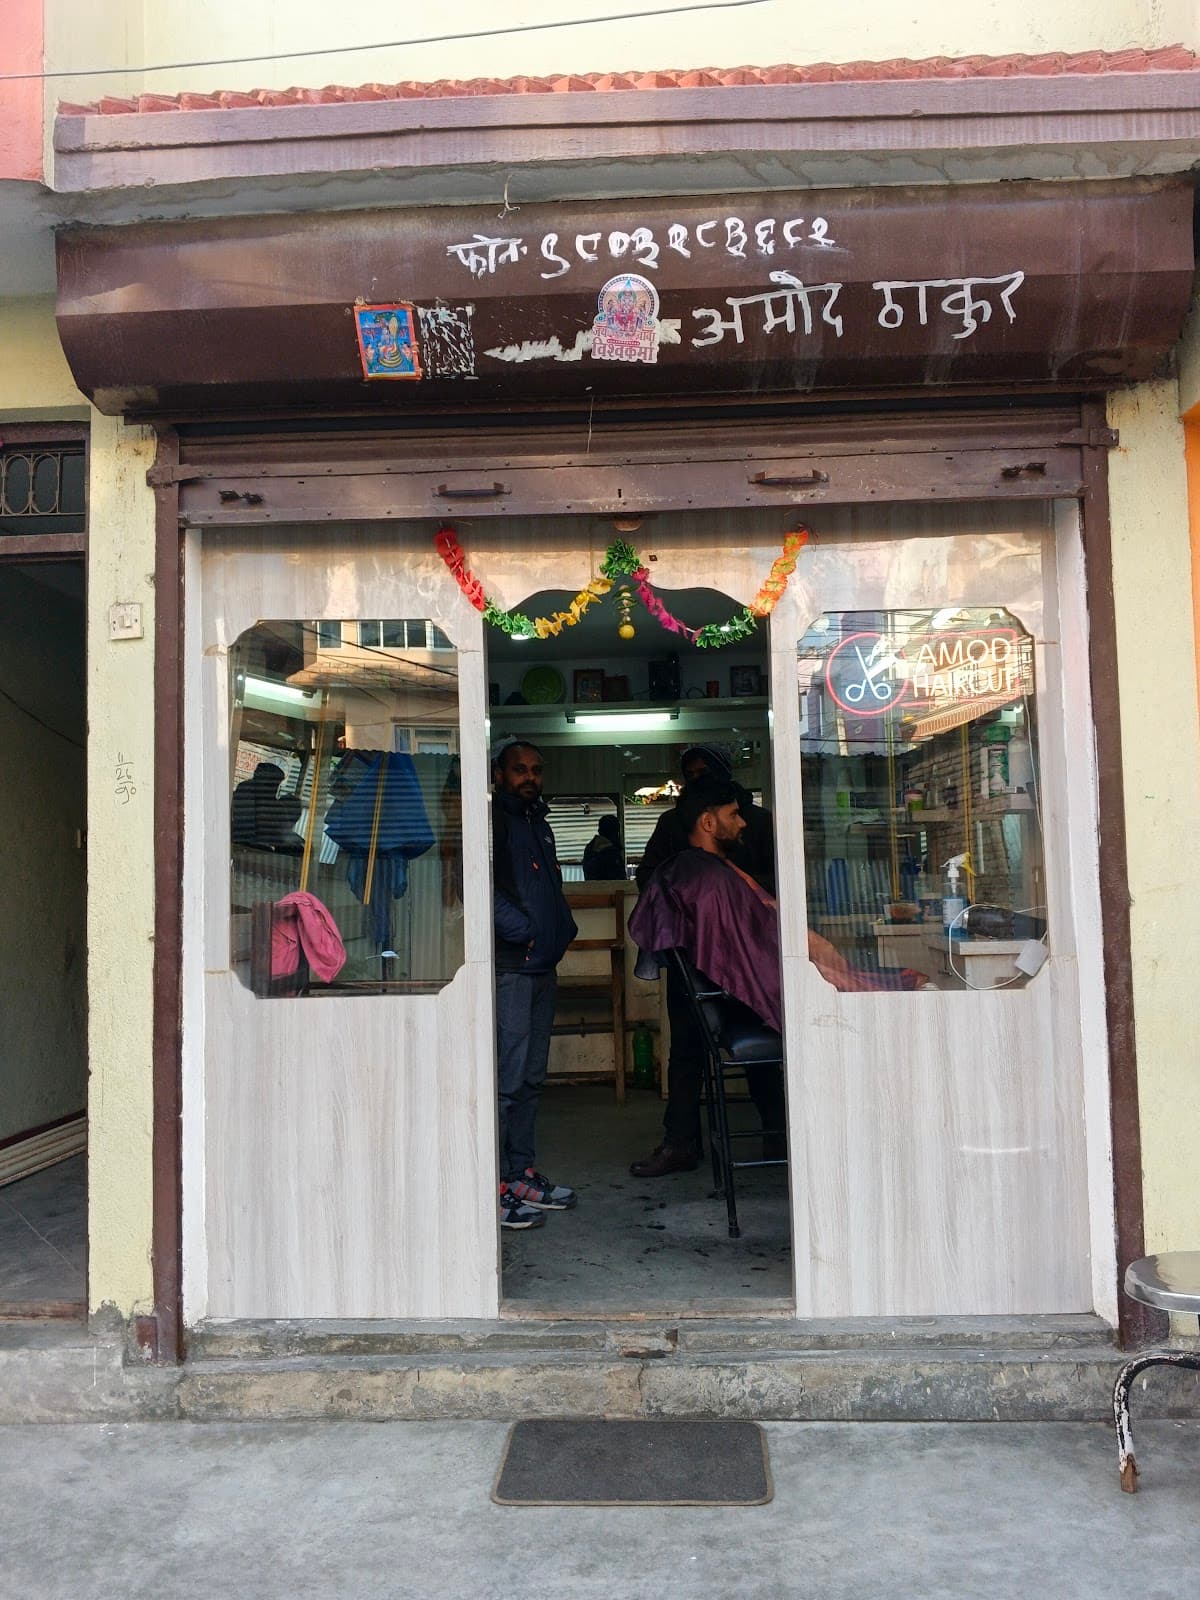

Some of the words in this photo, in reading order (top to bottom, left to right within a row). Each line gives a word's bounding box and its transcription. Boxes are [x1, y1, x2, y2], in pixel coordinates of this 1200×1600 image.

[692, 270, 843, 348] अमोद
[872, 271, 1025, 340] ठाकुर
[592, 337, 655, 361] विश्वकर्मा
[917, 637, 1011, 667] AMOD
[911, 667, 1017, 698] HAIRCUT
